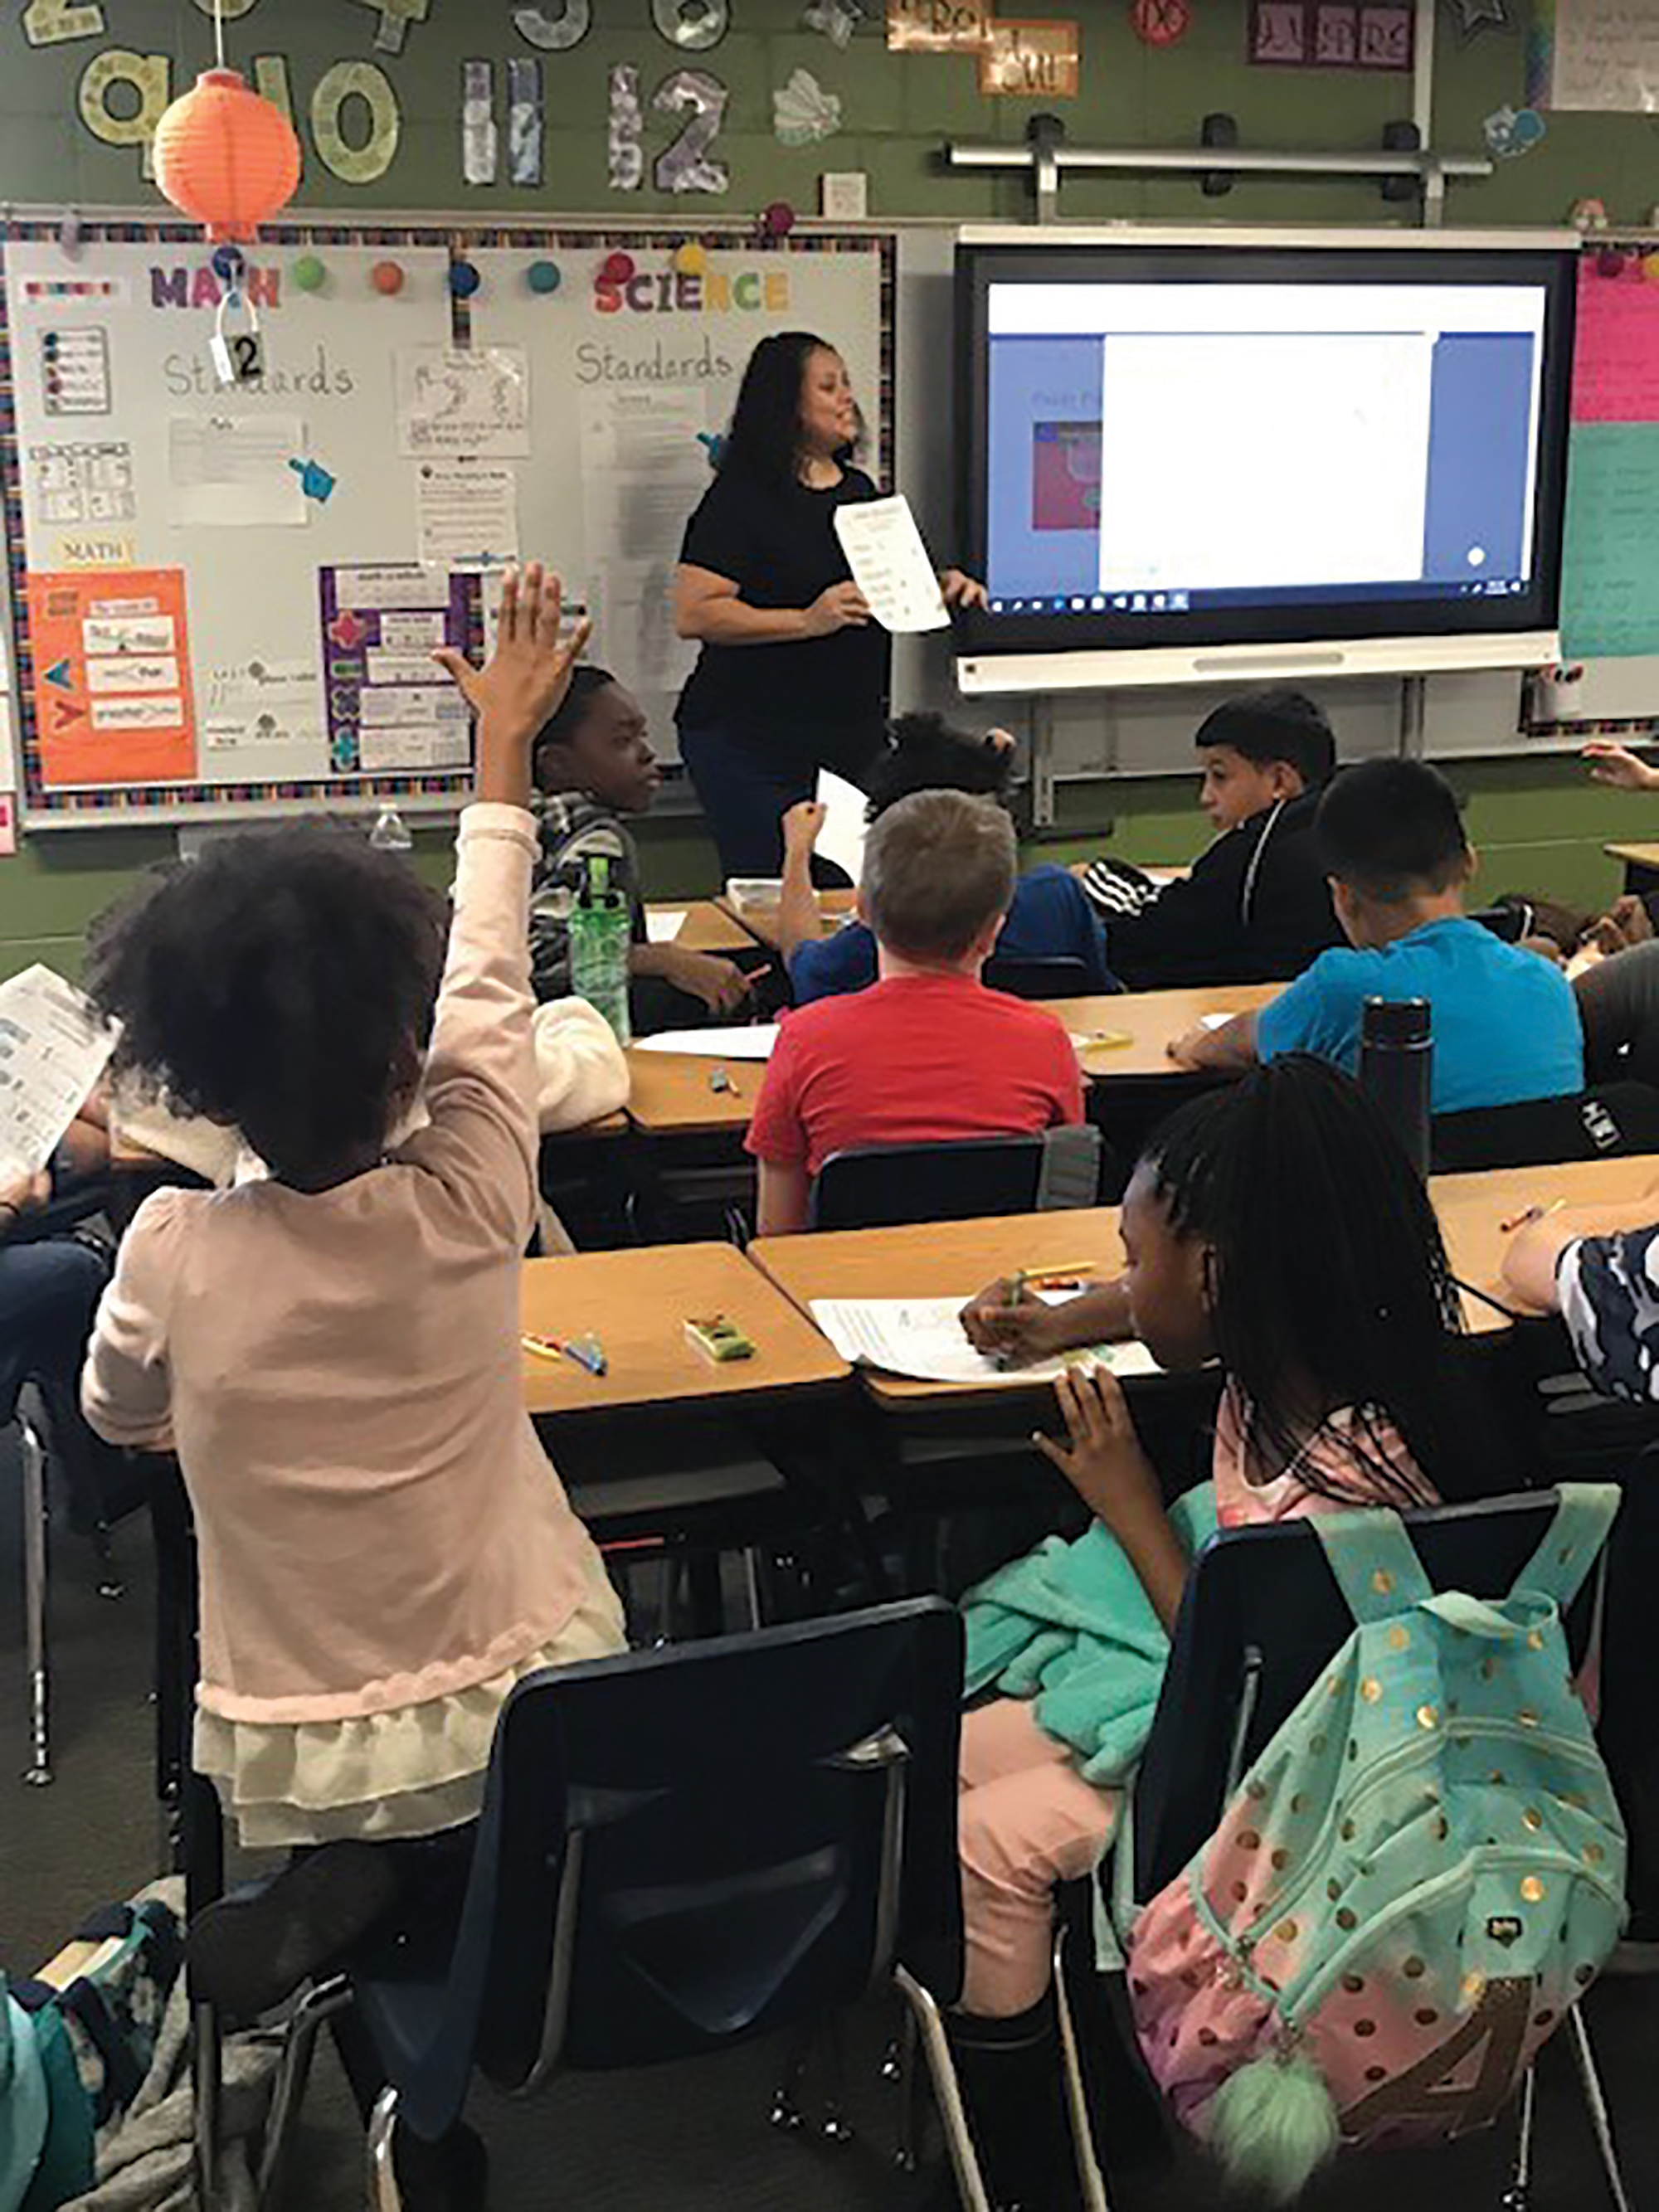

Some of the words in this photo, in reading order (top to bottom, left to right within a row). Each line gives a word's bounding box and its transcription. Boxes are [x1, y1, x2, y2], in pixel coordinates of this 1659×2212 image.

[463, 58, 542, 185] 11
[608, 65, 729, 193] 12
[593, 272, 789, 313] SCIENCE
[163, 344, 354, 396] Stards
[233, 336, 261, 377] 2
[63, 541, 124, 560] MATH
